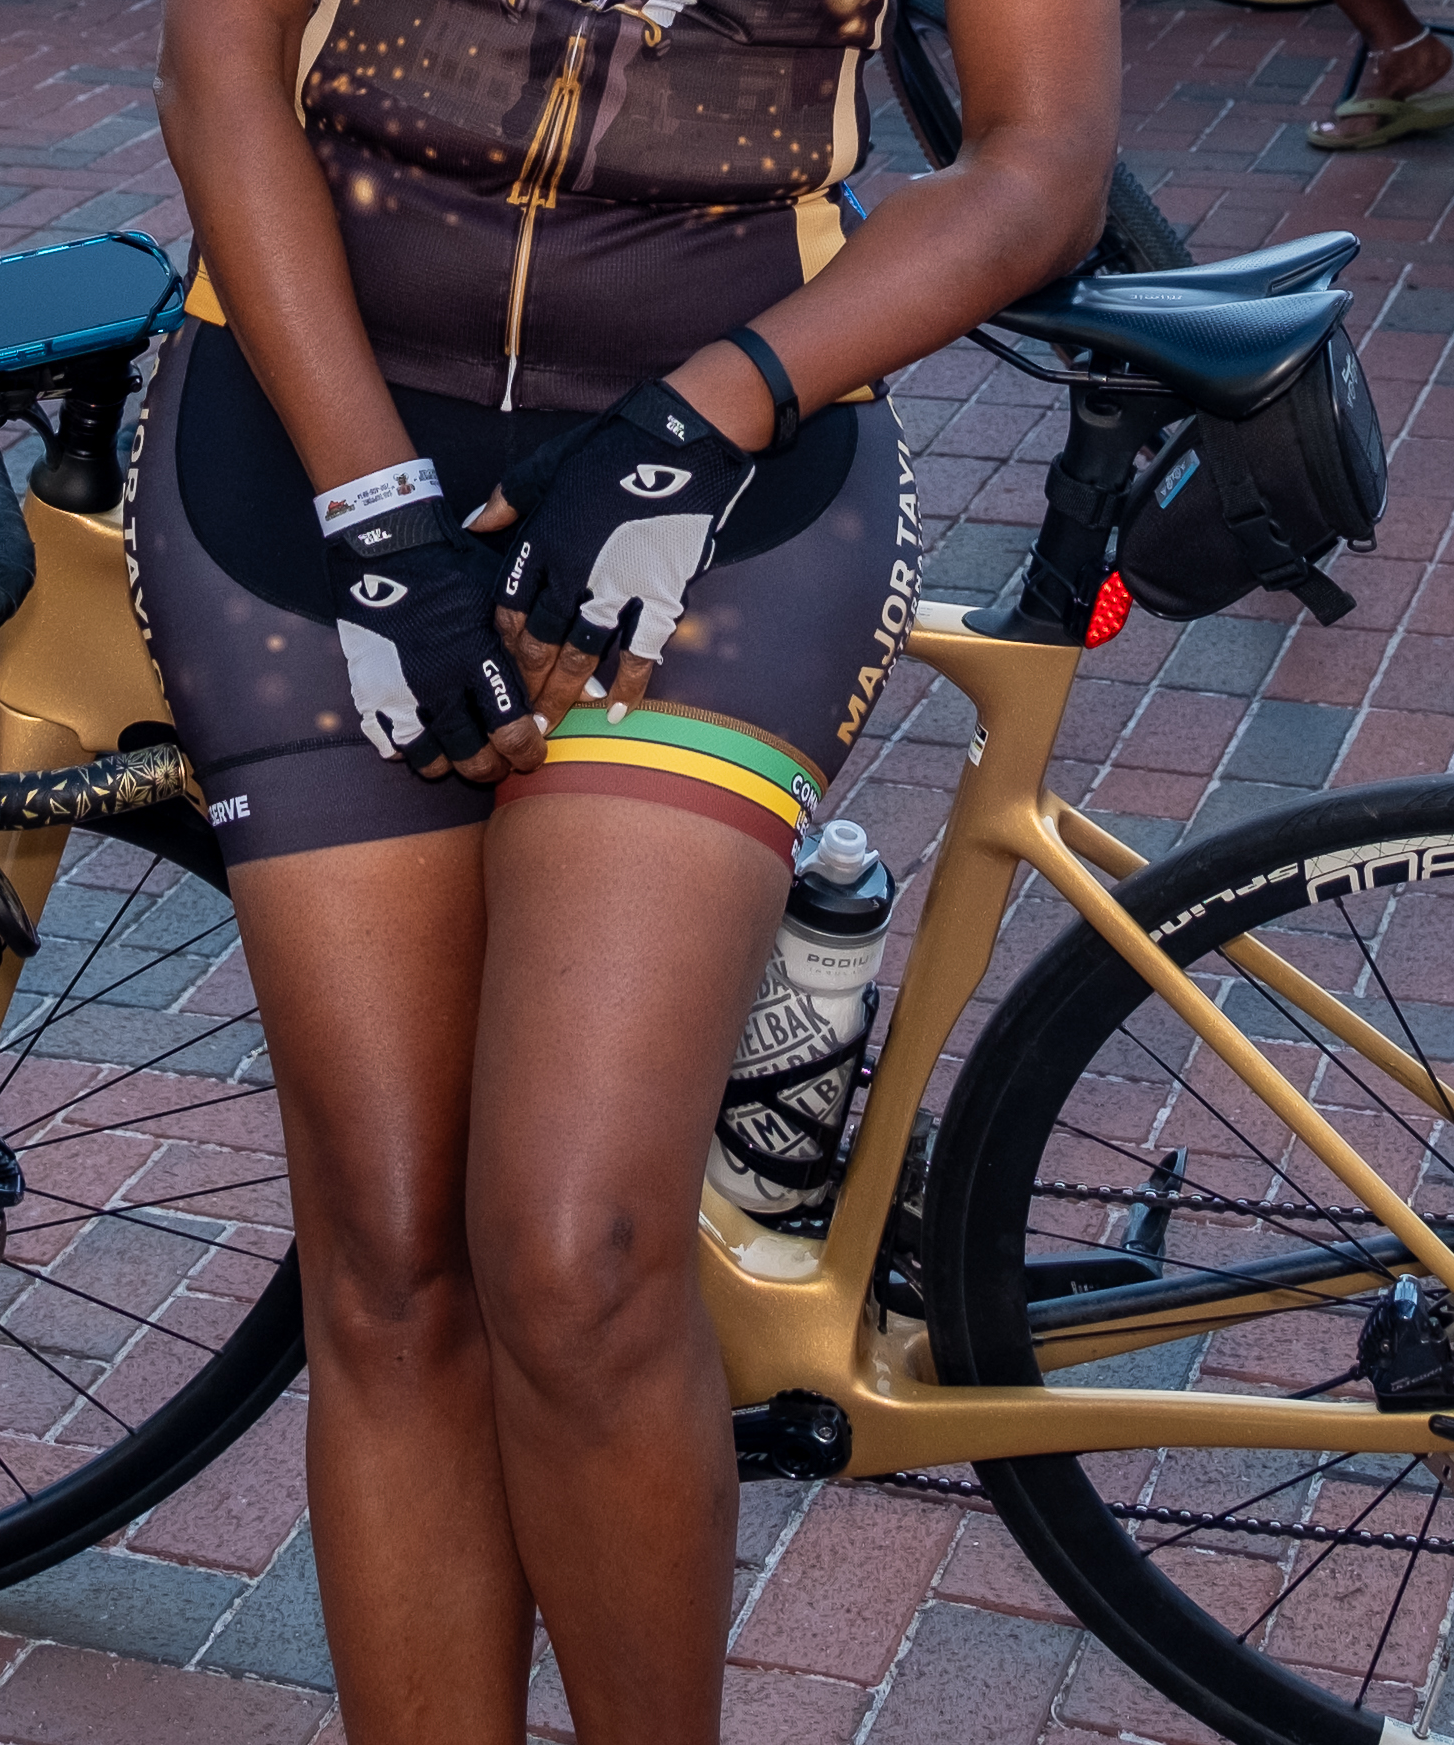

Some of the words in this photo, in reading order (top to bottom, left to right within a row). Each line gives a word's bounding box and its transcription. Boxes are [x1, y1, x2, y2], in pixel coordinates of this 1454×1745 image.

[506, 540, 532, 599] GIRO
[836, 558, 916, 746] MAJOR
[482, 658, 514, 715] GIRO
